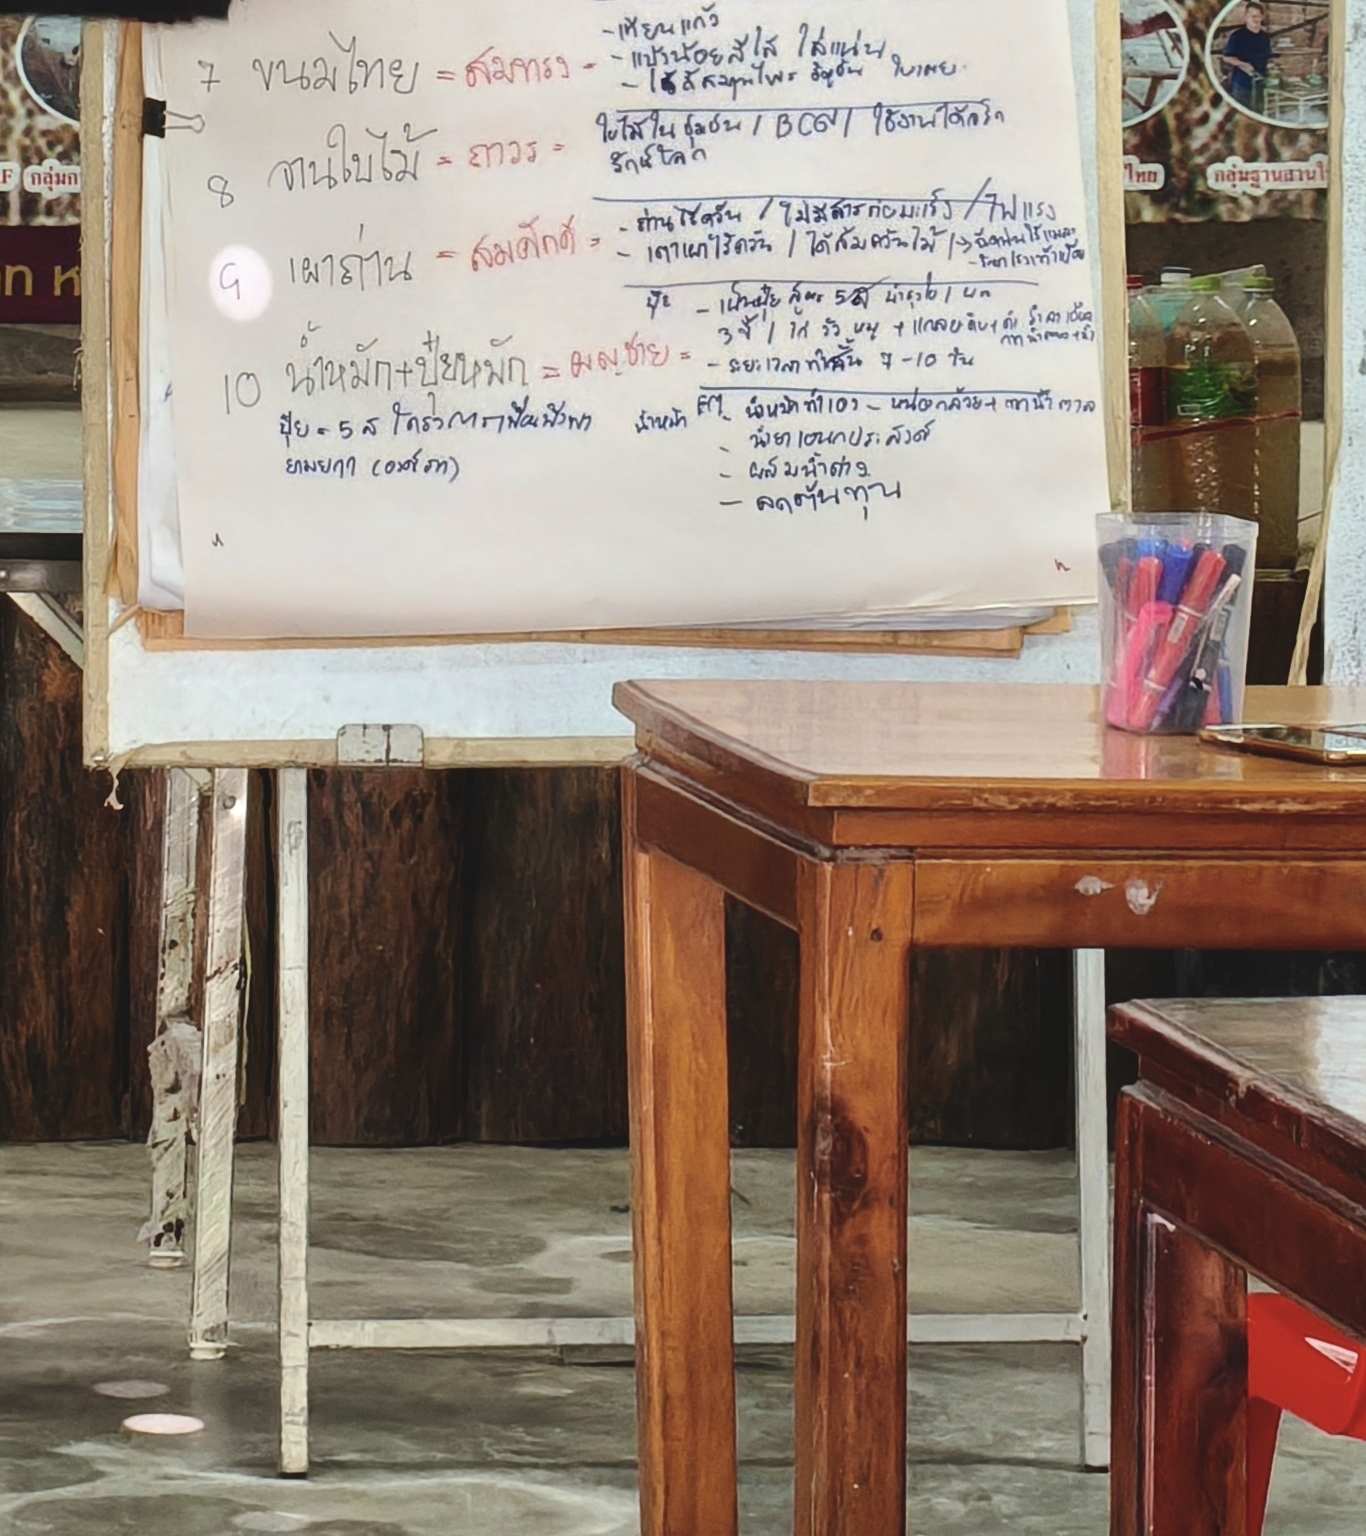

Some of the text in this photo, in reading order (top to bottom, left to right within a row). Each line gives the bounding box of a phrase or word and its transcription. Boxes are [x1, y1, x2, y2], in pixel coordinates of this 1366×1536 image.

[198, 60, 222, 93] 7
[207, 175, 235, 208] 8
[225, 372, 262, 414] 10
